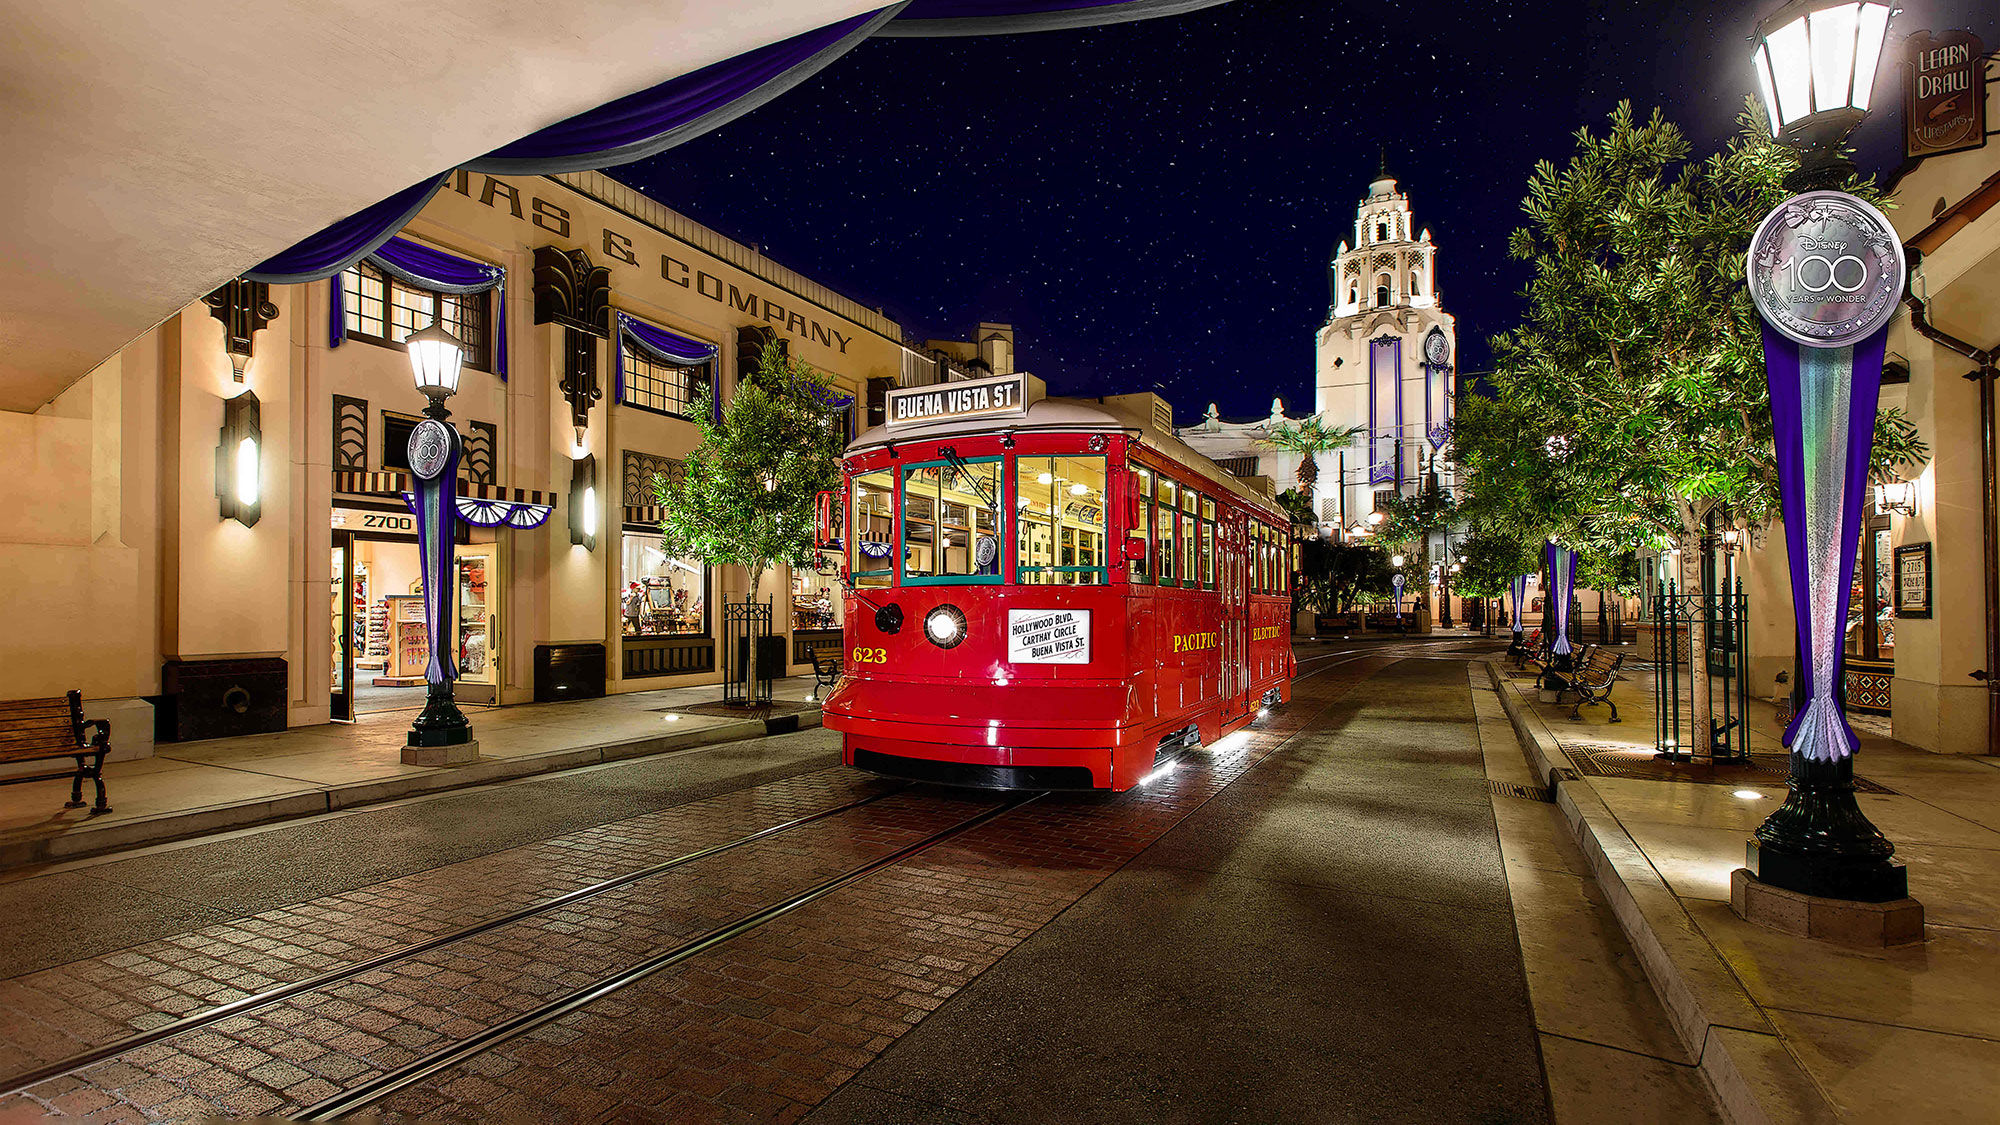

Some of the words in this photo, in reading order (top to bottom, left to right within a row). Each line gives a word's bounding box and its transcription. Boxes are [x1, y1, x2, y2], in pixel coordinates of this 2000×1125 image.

[1919, 43, 1969, 72] LEARN
[1918, 70, 1969, 99] DRAW
[1923, 114, 1967, 139] UPSTAIRS
[443, 168, 571, 239] IAS
[602, 228, 640, 268] &
[661, 254, 852, 355] COMPANY
[1780, 254, 1868, 293] 100
[1786, 295, 1815, 304] YEARS
[1825, 295, 1867, 304] WONDER
[897, 393, 943, 419] BUENA
[948, 387, 990, 413] VISTA
[993, 384, 1014, 407] ST
[364, 514, 411, 529] 2700
[1012, 617, 1054, 636] HOLLYWOOD
[1055, 612, 1073, 625] BLVD.
[1022, 631, 1051, 646] CARTHAY
[1054, 625, 1076, 638] CIRCLE
[1032, 645, 1053, 658] BUENA
[1055, 640, 1074, 652] VISTA
[1075, 637, 1085, 648] ST.
[1173, 632, 1217, 653] PACIFIC
[1253, 625, 1280, 641] ELECTRIC
[852, 647, 888, 664] 623
